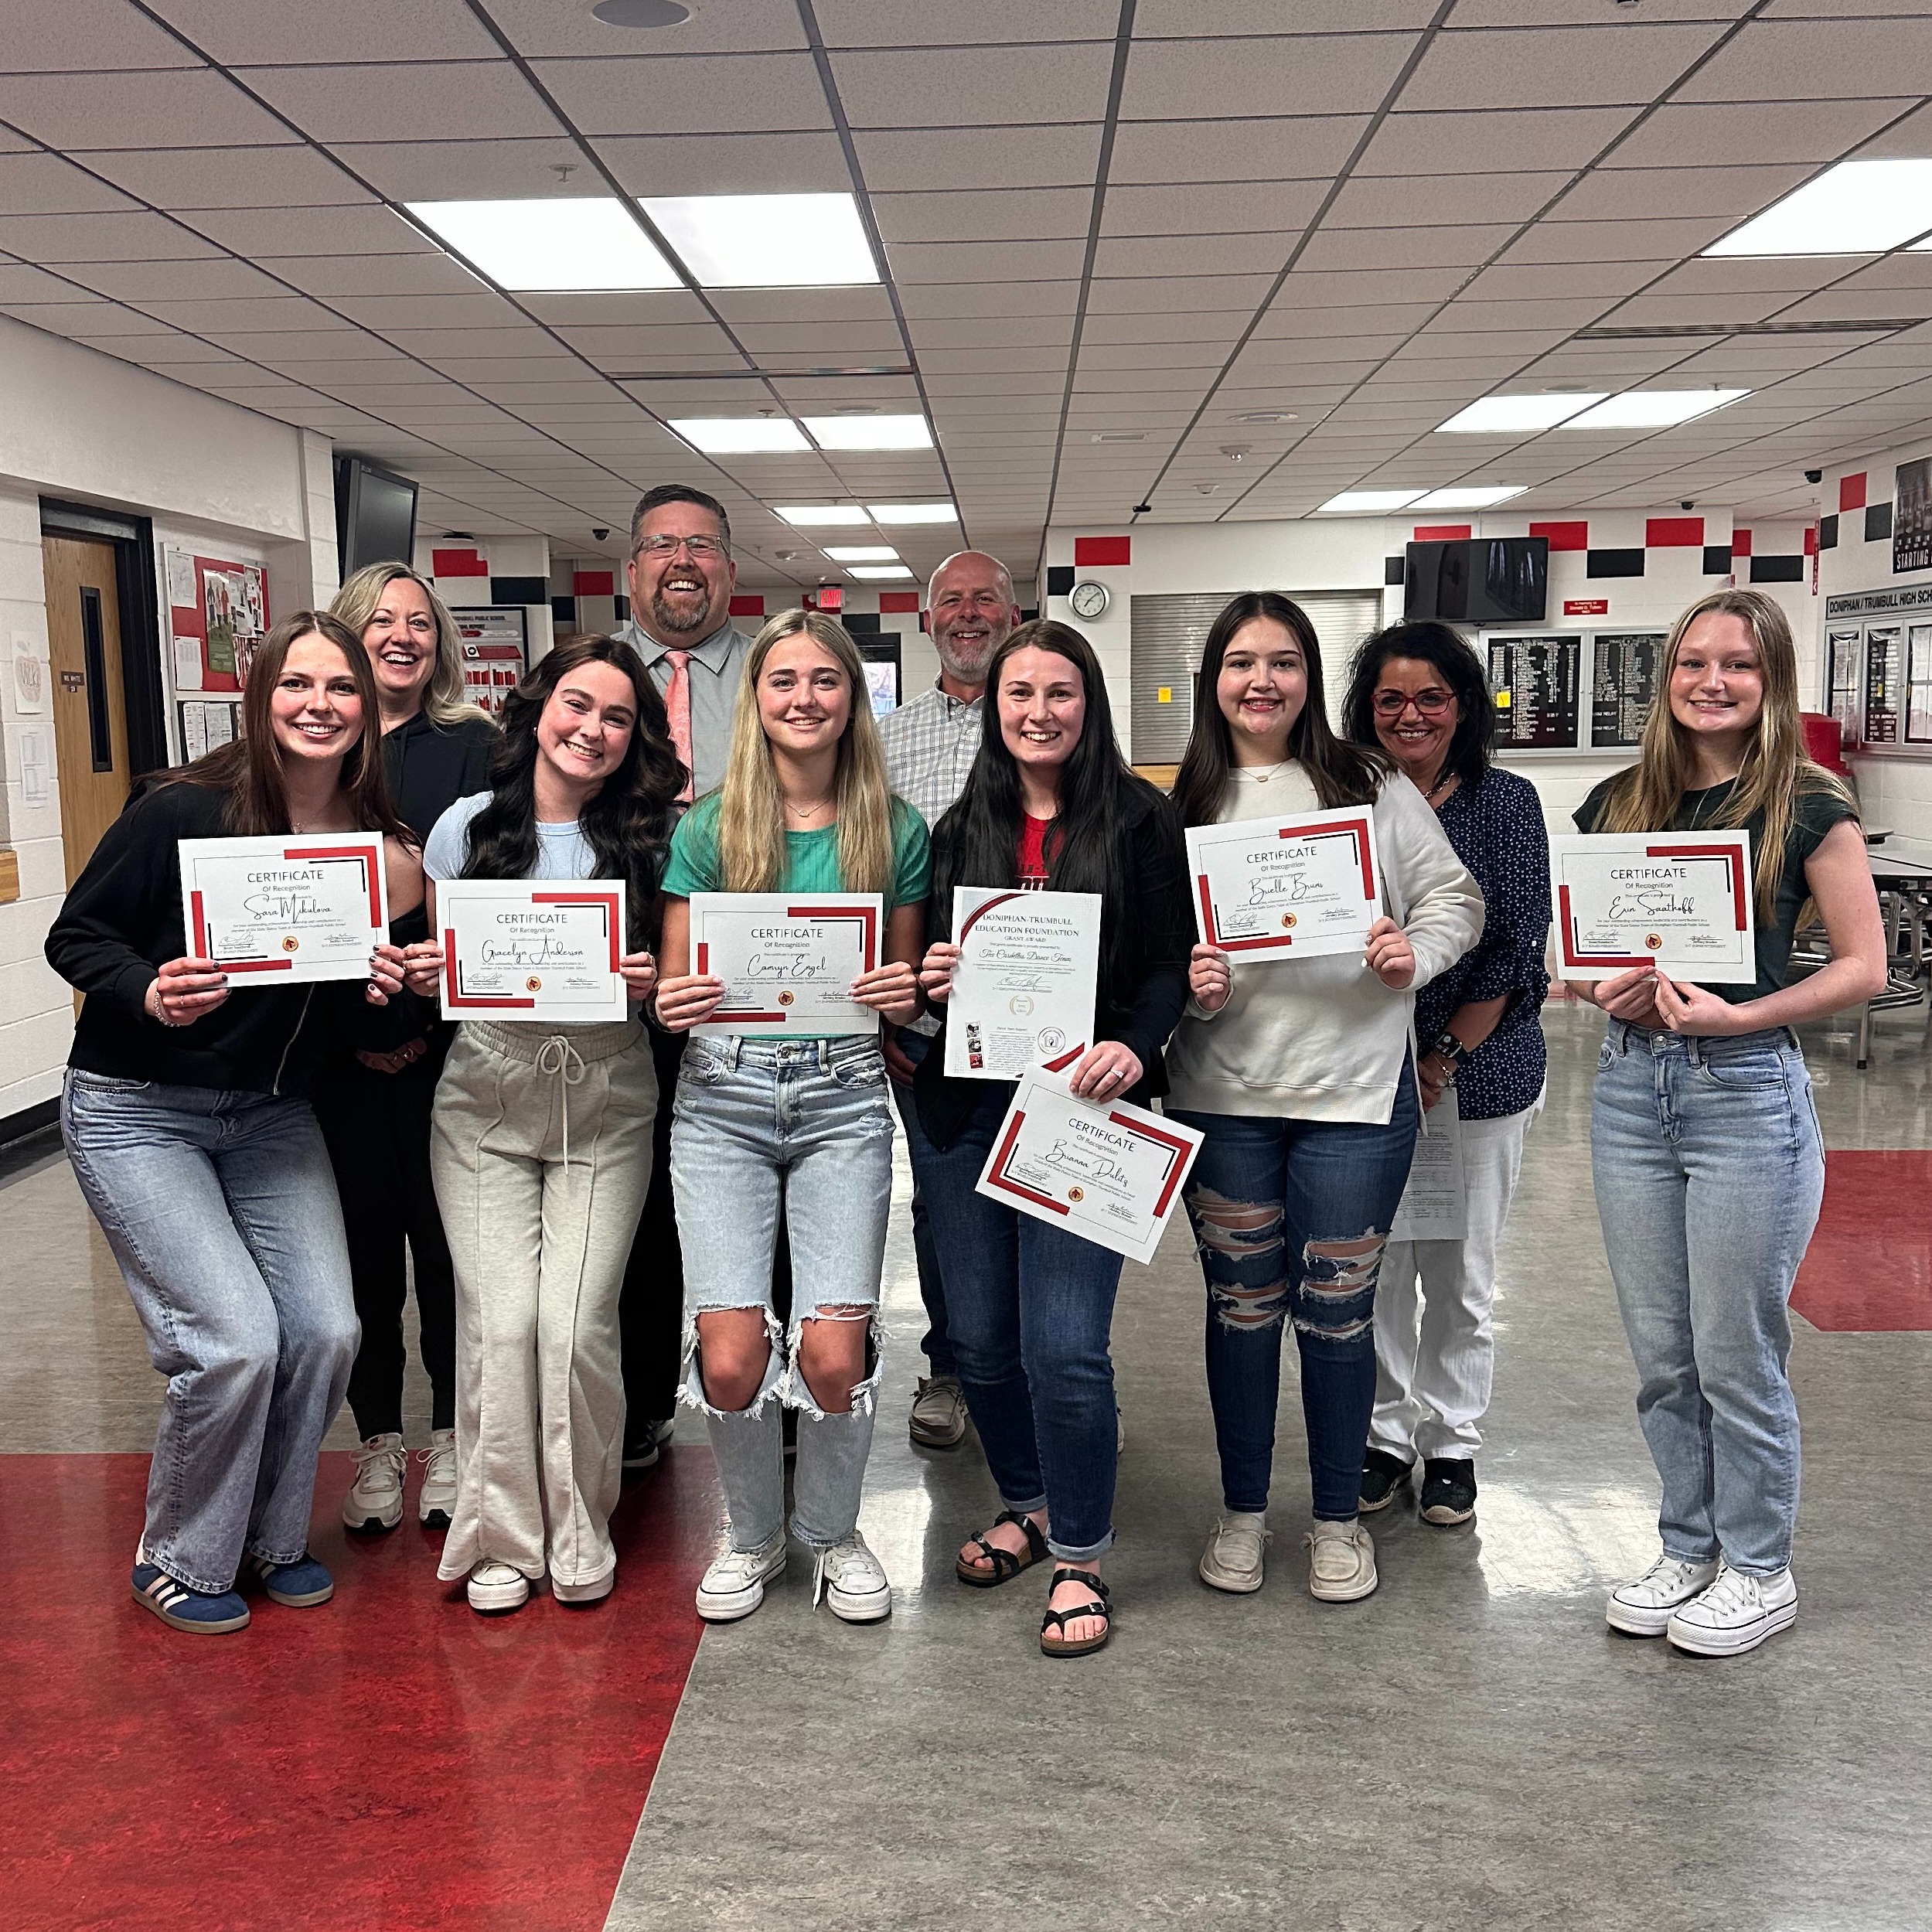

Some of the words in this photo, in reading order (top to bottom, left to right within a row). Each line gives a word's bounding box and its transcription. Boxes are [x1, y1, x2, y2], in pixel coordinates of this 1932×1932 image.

[1897, 549, 1929, 570] STARTING
[1865, 594, 1898, 609] TRUMBULL
[1900, 591, 1917, 606] HIGH
[1246, 846, 1317, 864] CERTIFICATE
[247, 870, 325, 883] CERTIFICATE
[1610, 867, 1687, 880] CERTIFICATE
[244, 894, 278, 920] Sara
[280, 894, 332, 924] Mikulova
[1609, 895, 1636, 919] Erin
[1637, 890, 1695, 915] Saathoff
[496, 914, 568, 924] CERTIFICATE
[751, 929, 823, 939] CERTIFICATE
[975, 925, 1024, 934] EDUCATION
[1024, 927, 1080, 937] FOUNDATION
[482, 939, 527, 964] Gracelyn
[529, 934, 584, 965] Anderson
[1027, 951, 1050, 961] Dance
[1051, 952, 1072, 963] Team
[747, 953, 789, 979] Camryn
[791, 954, 827, 979] Engel
[1068, 1118, 1137, 1153] CERTIFICATE
[1045, 1138, 1089, 1168] Brianna
